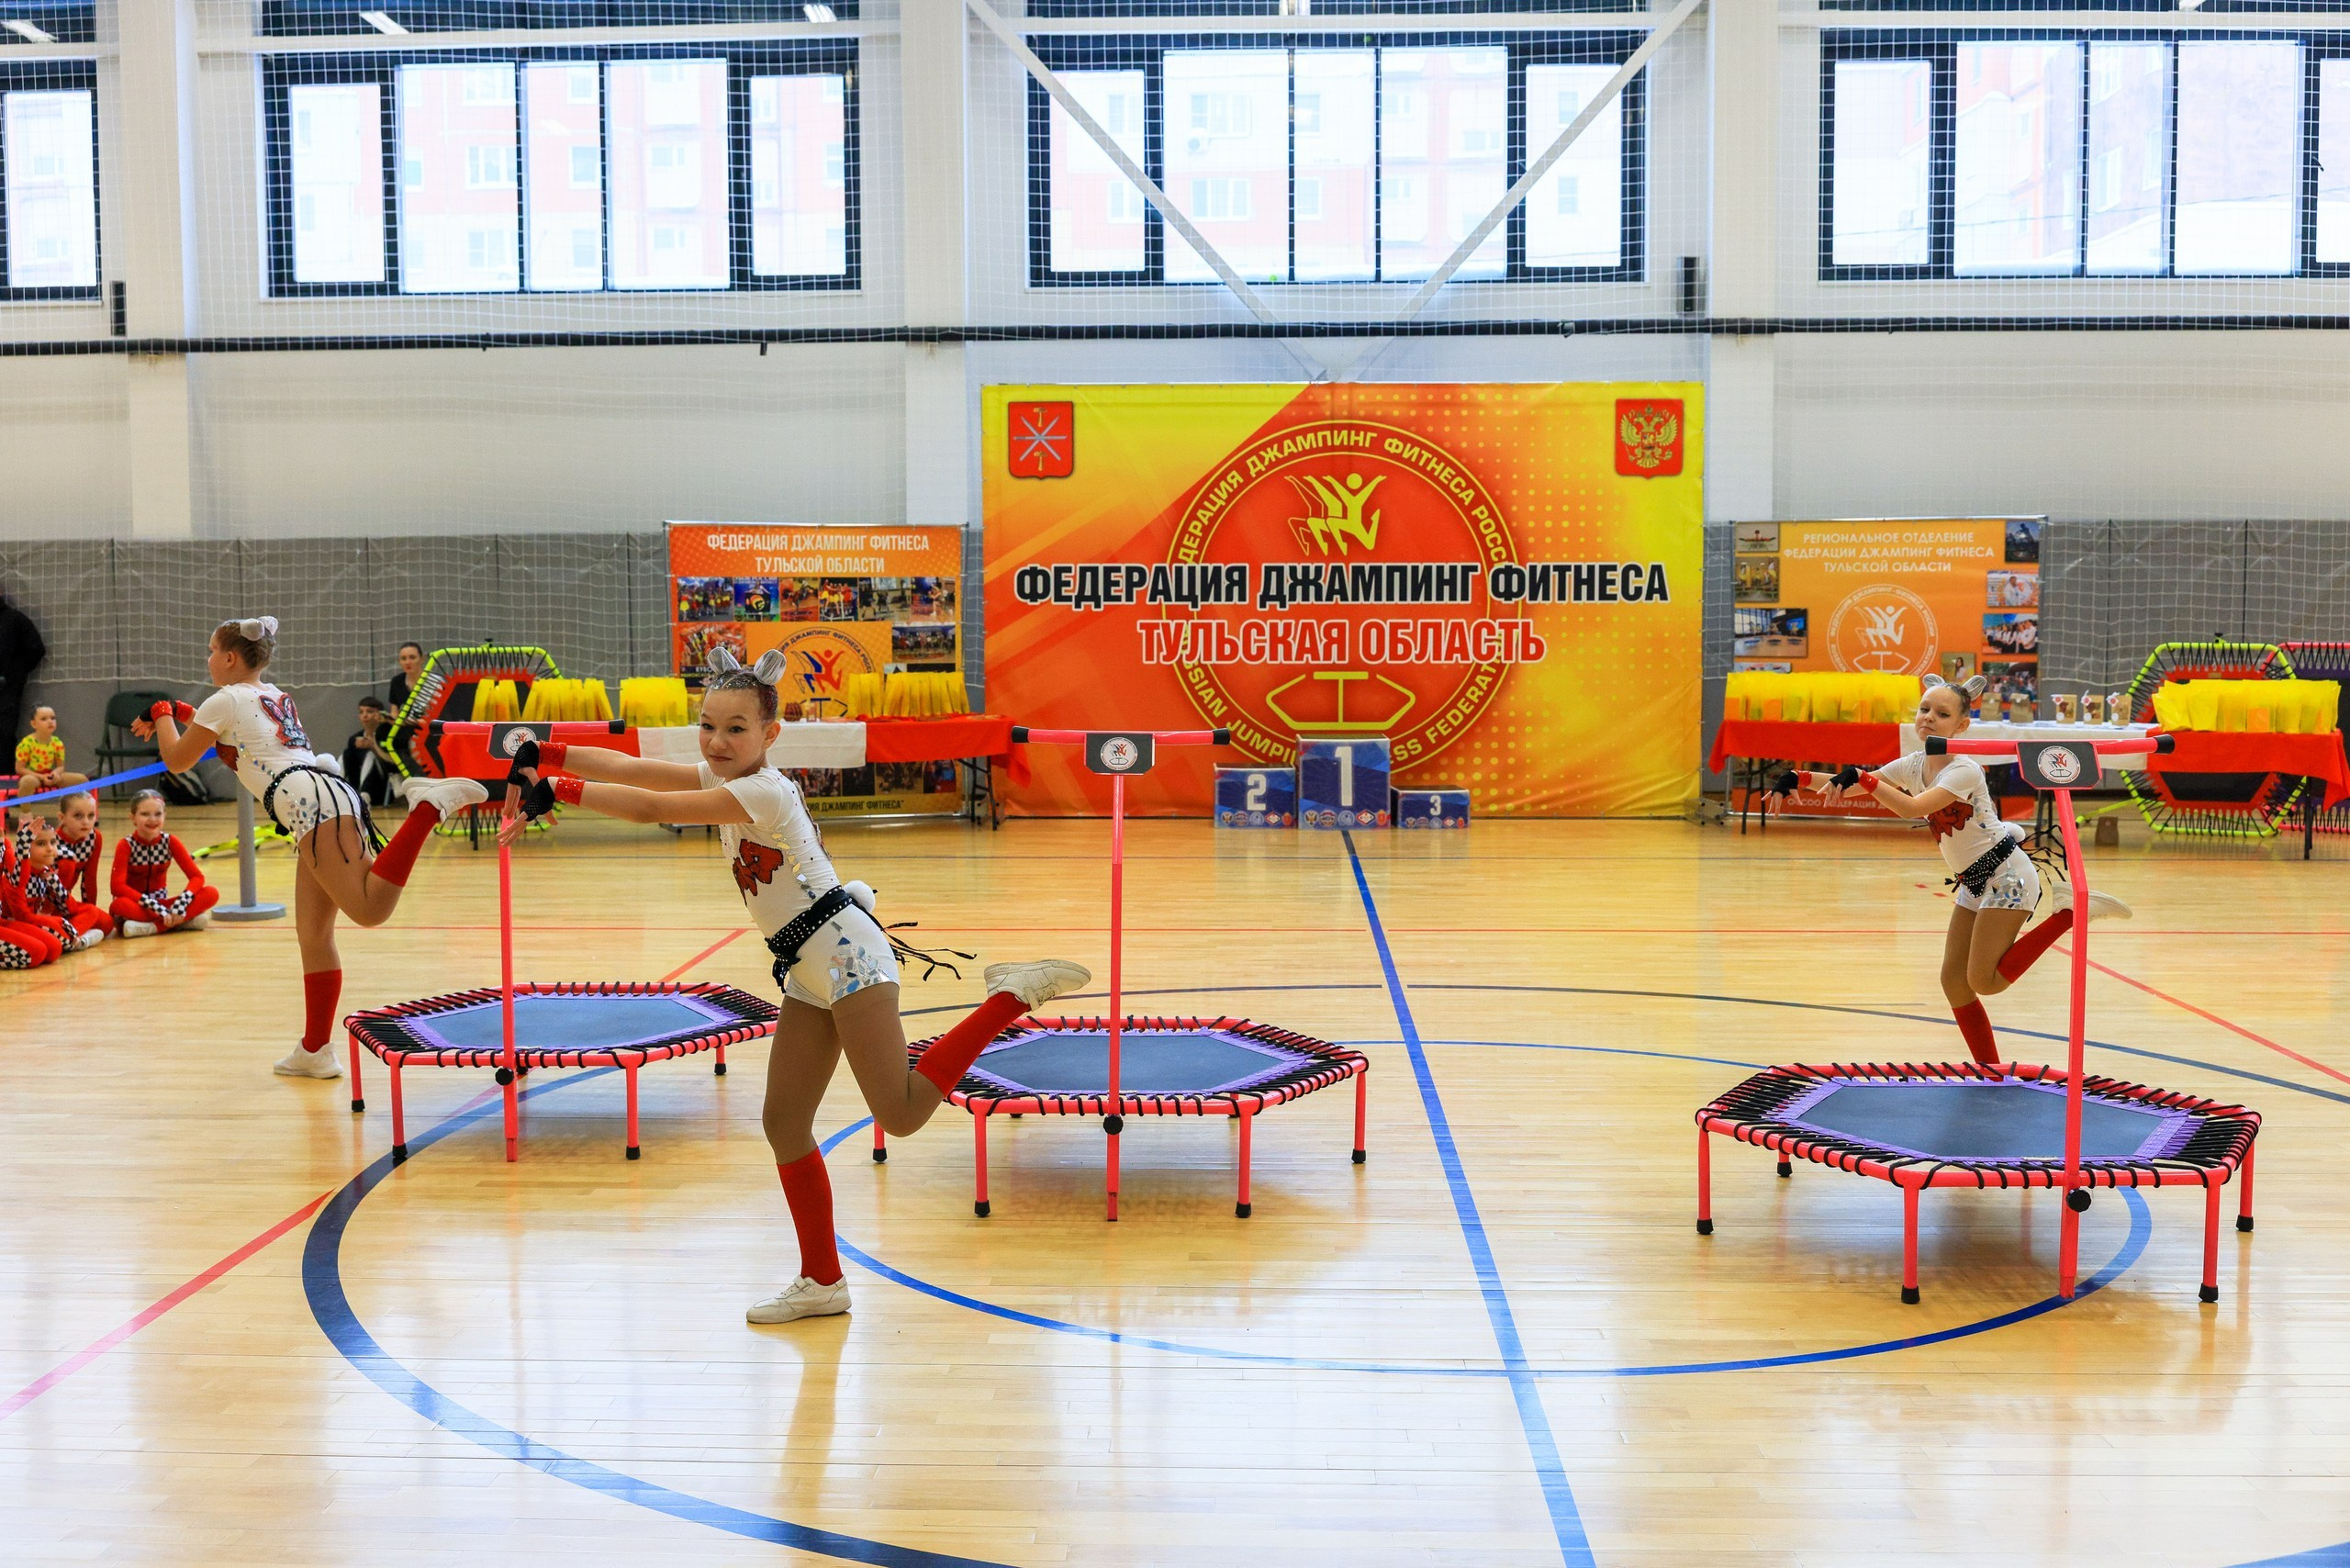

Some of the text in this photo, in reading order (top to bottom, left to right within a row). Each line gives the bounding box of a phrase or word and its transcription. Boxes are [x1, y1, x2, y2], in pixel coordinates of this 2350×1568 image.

[1178, 430, 1508, 566] ДЕРАЦИЯ ДЖАМПИНГ ФИТНЕСА РОСС
[707, 533, 930, 553] ФЕДЕРАЦИЯ ДЖАМПИНГ ФИТНЕСА
[1803, 532, 1975, 543] РЕГИОНАЛЬНОЕ ОТДЕЛЕНИЕ
[1784, 546, 1995, 559] ФЕДЕРАЦИИ ДЖАМПИНГ ФИТНЕСА
[755, 555, 885, 574] ТУЛЬСКОЙ ОБЛАСТИ
[1823, 560, 1952, 573] ТУЛЬСКОЙ ОБЛАСТИ
[1015, 561, 1669, 610] ФЕДЕРАЦИЯ ДЖАМПИНГ ФИТНЕСА
[1137, 619, 1548, 665] ТУЛЬСКАЯ ОБЛАСТЬ
[1226, 719, 1297, 765] JUMPI
[1335, 745, 1353, 807] 1
[1247, 774, 1267, 812] 2
[821, 801, 865, 812] ДЖАМПИНГ
[1429, 795, 1442, 816] 3
